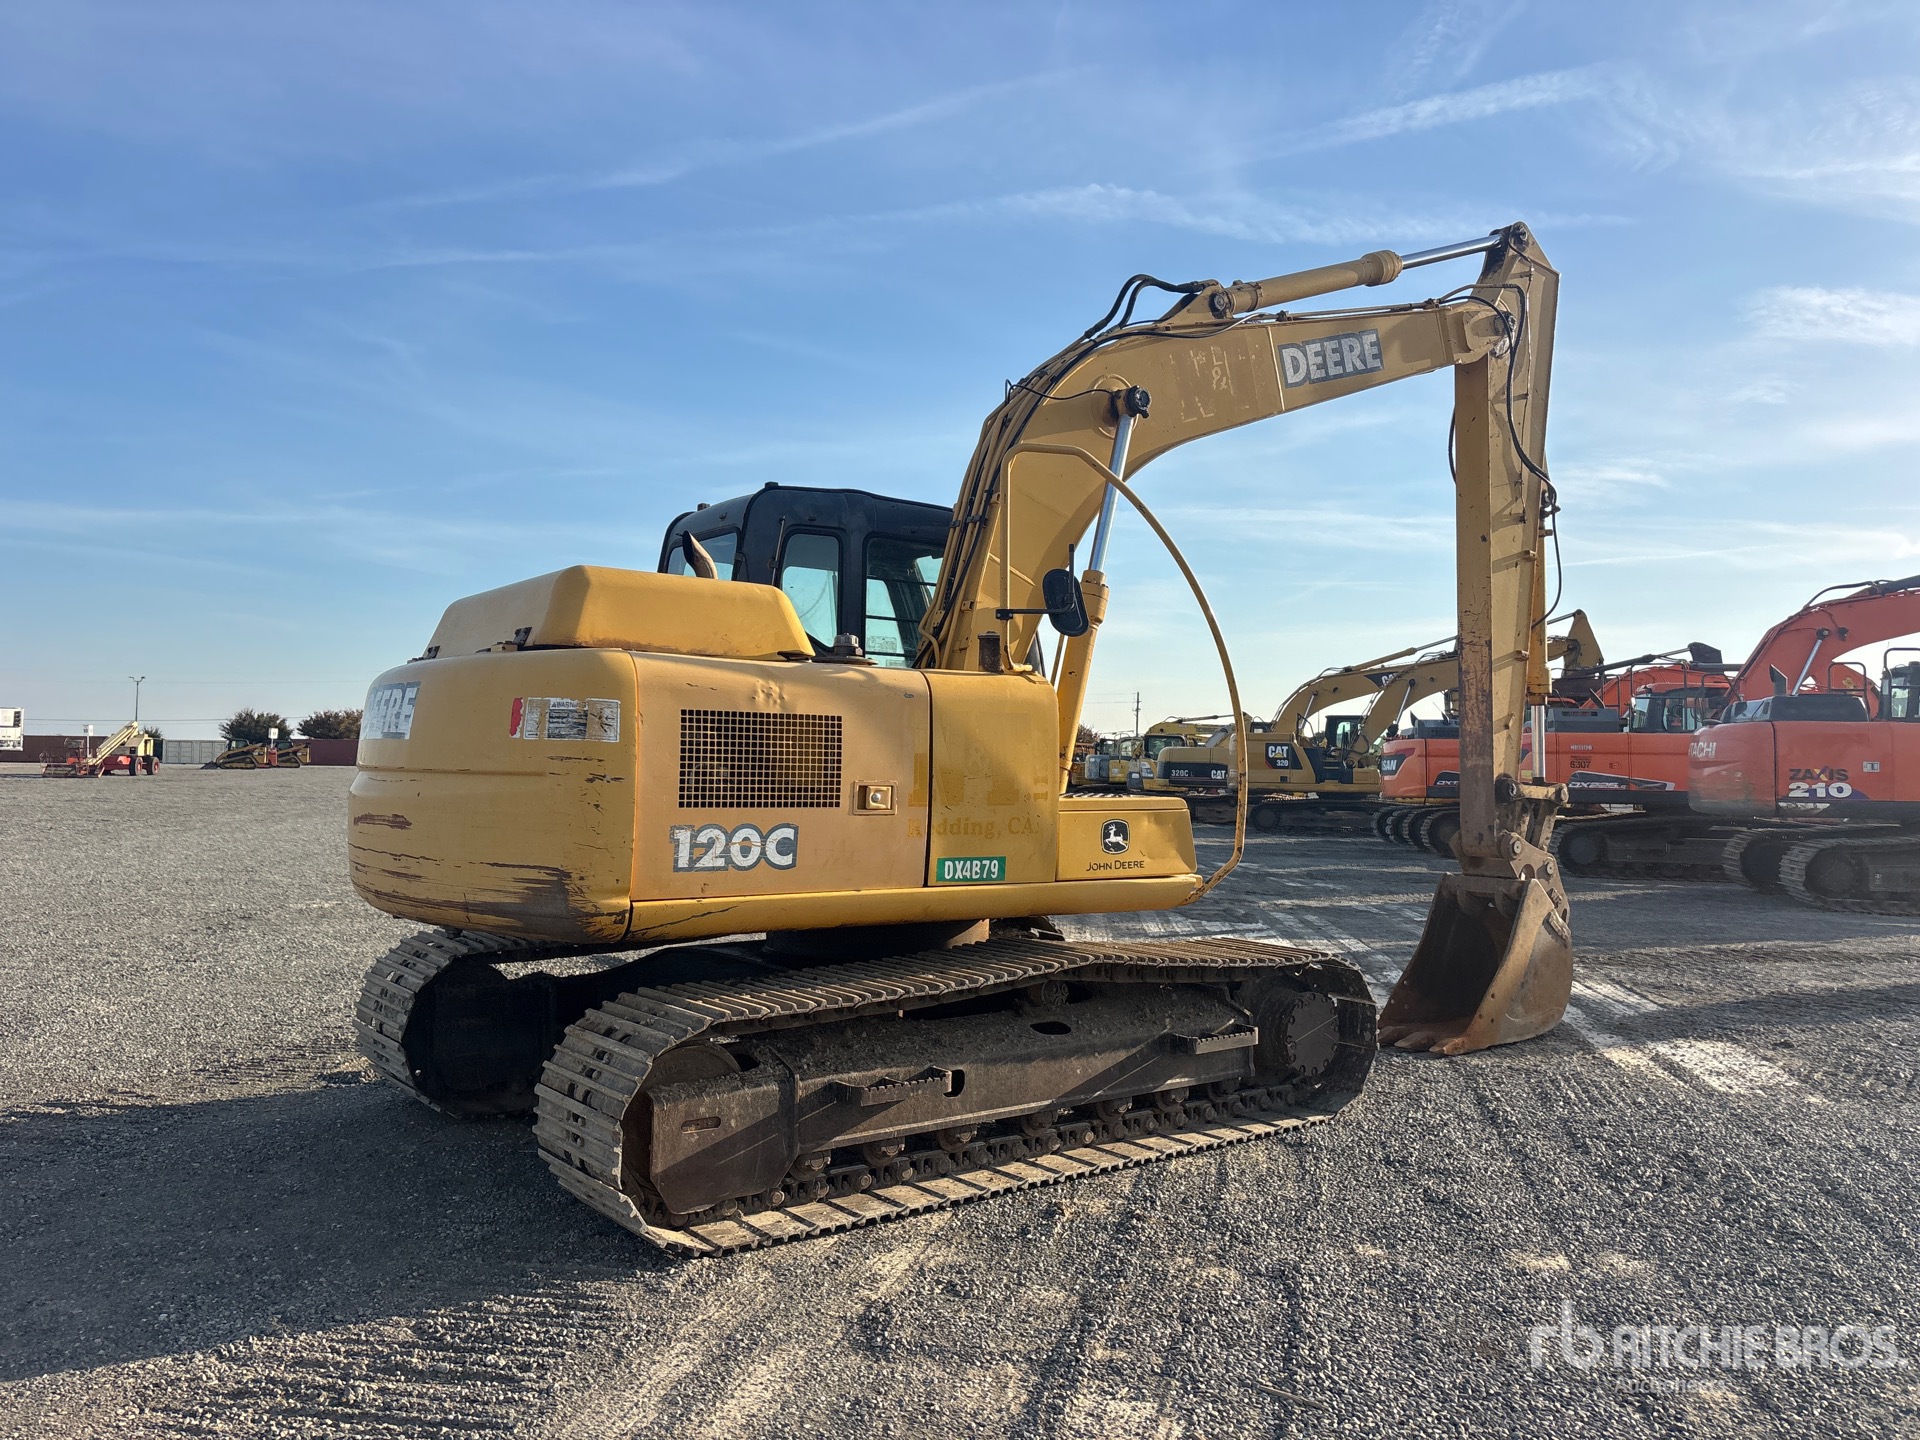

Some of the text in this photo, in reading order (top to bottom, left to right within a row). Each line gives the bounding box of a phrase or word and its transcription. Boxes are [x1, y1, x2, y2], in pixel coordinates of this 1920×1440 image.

[1279, 331, 1383, 386] DEERE
[1268, 745, 1289, 758] CAT
[1276, 759, 1289, 767] 320
[1171, 769, 1189, 777] 320C
[1211, 770, 1226, 779] CAT
[1788, 766, 1849, 781] ZAXIS
[1788, 782, 1853, 798] 210
[672, 825, 797, 871] 120C
[944, 859, 999, 880] DX4B79
[1086, 860, 1145, 872] JOHN DEERE
